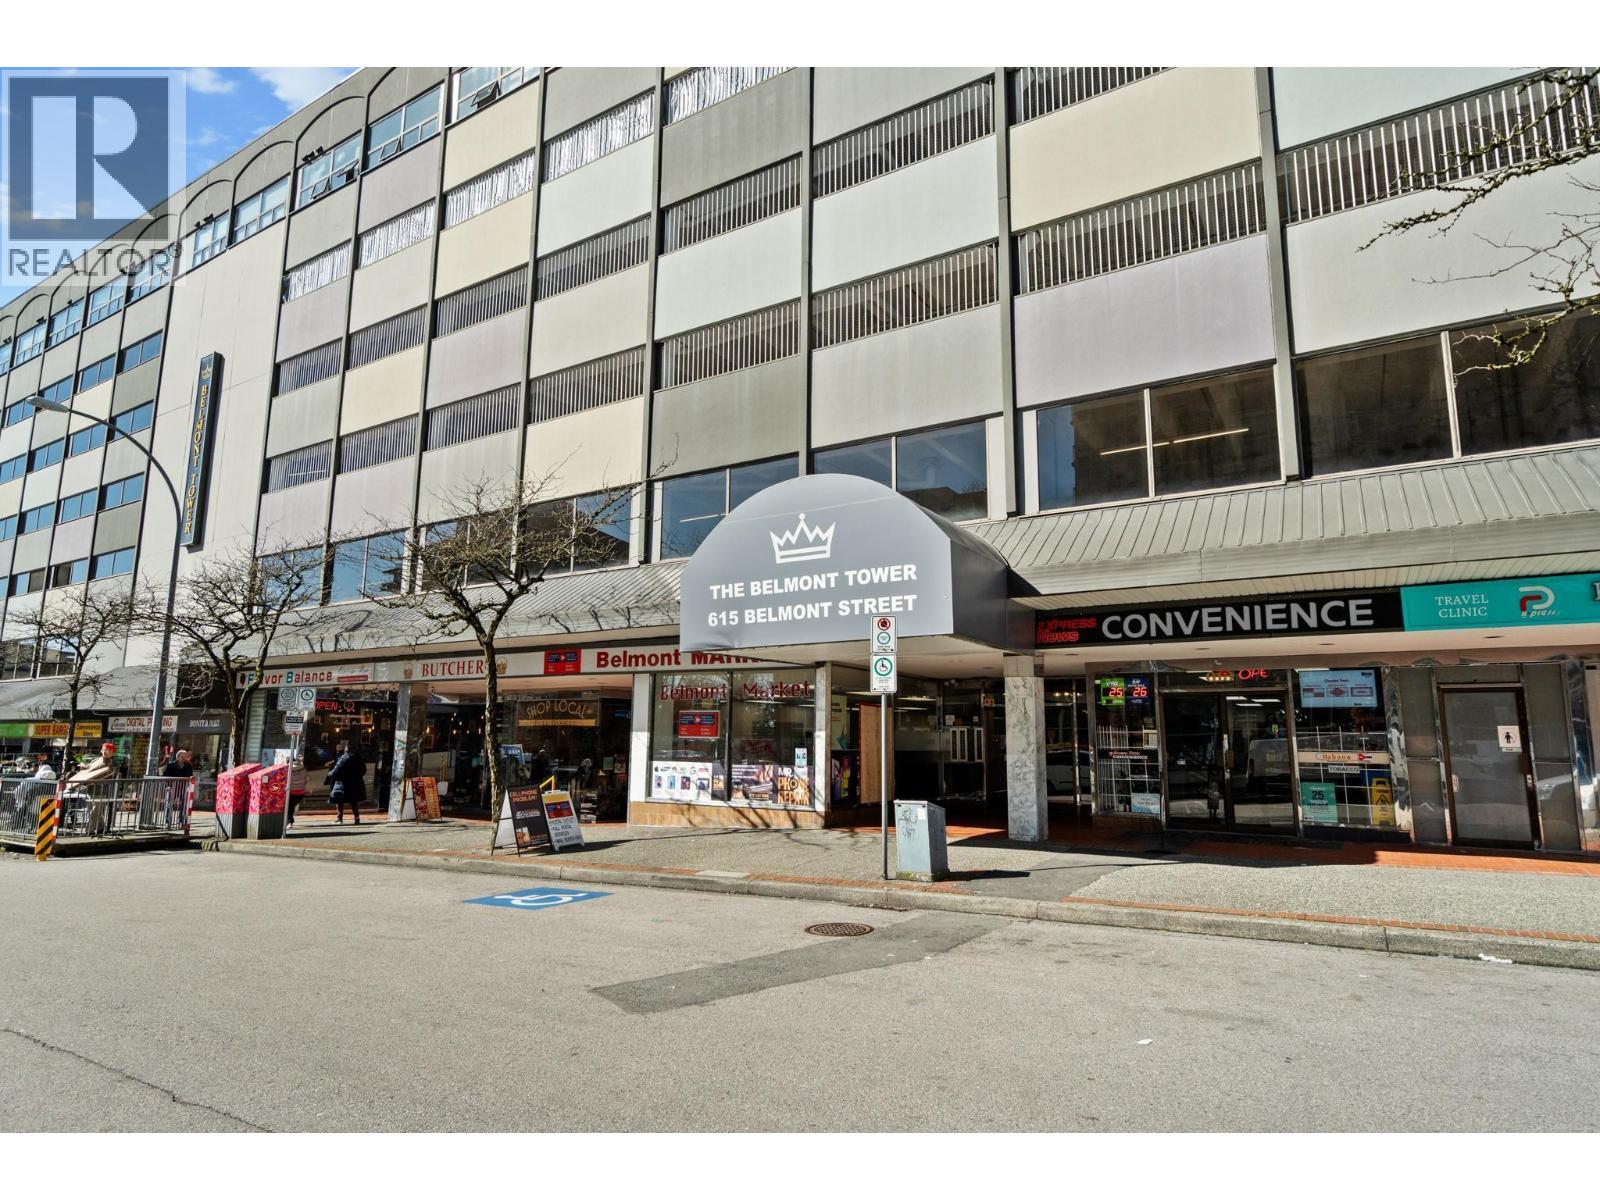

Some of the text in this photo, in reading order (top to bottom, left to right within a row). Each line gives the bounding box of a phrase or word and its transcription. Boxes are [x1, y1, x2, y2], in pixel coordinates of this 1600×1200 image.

[184, 385, 208, 534] BELMONT TOWER
[710, 564, 918, 600] THE BELMONT TOWER
[1435, 594, 1488, 606] TRAVEL
[707, 595, 917, 627] 615 BELMONT STREET
[1101, 599, 1374, 639] CONVENIENCE
[1438, 607, 1488, 618] CLINIC
[422, 659, 488, 677] BUTCHER
[596, 650, 680, 668] Belmont
[247, 673, 282, 685] Fvor
[286, 671, 333, 683] Balance
[660, 681, 810, 701] Belmont Market
[1109, 687, 1123, 697] 25
[1133, 687, 1147, 697] 26
[527, 700, 586, 719] SHOP LOCAL
[778, 767, 794, 777] MR.
[1312, 790, 1325, 801] 25
